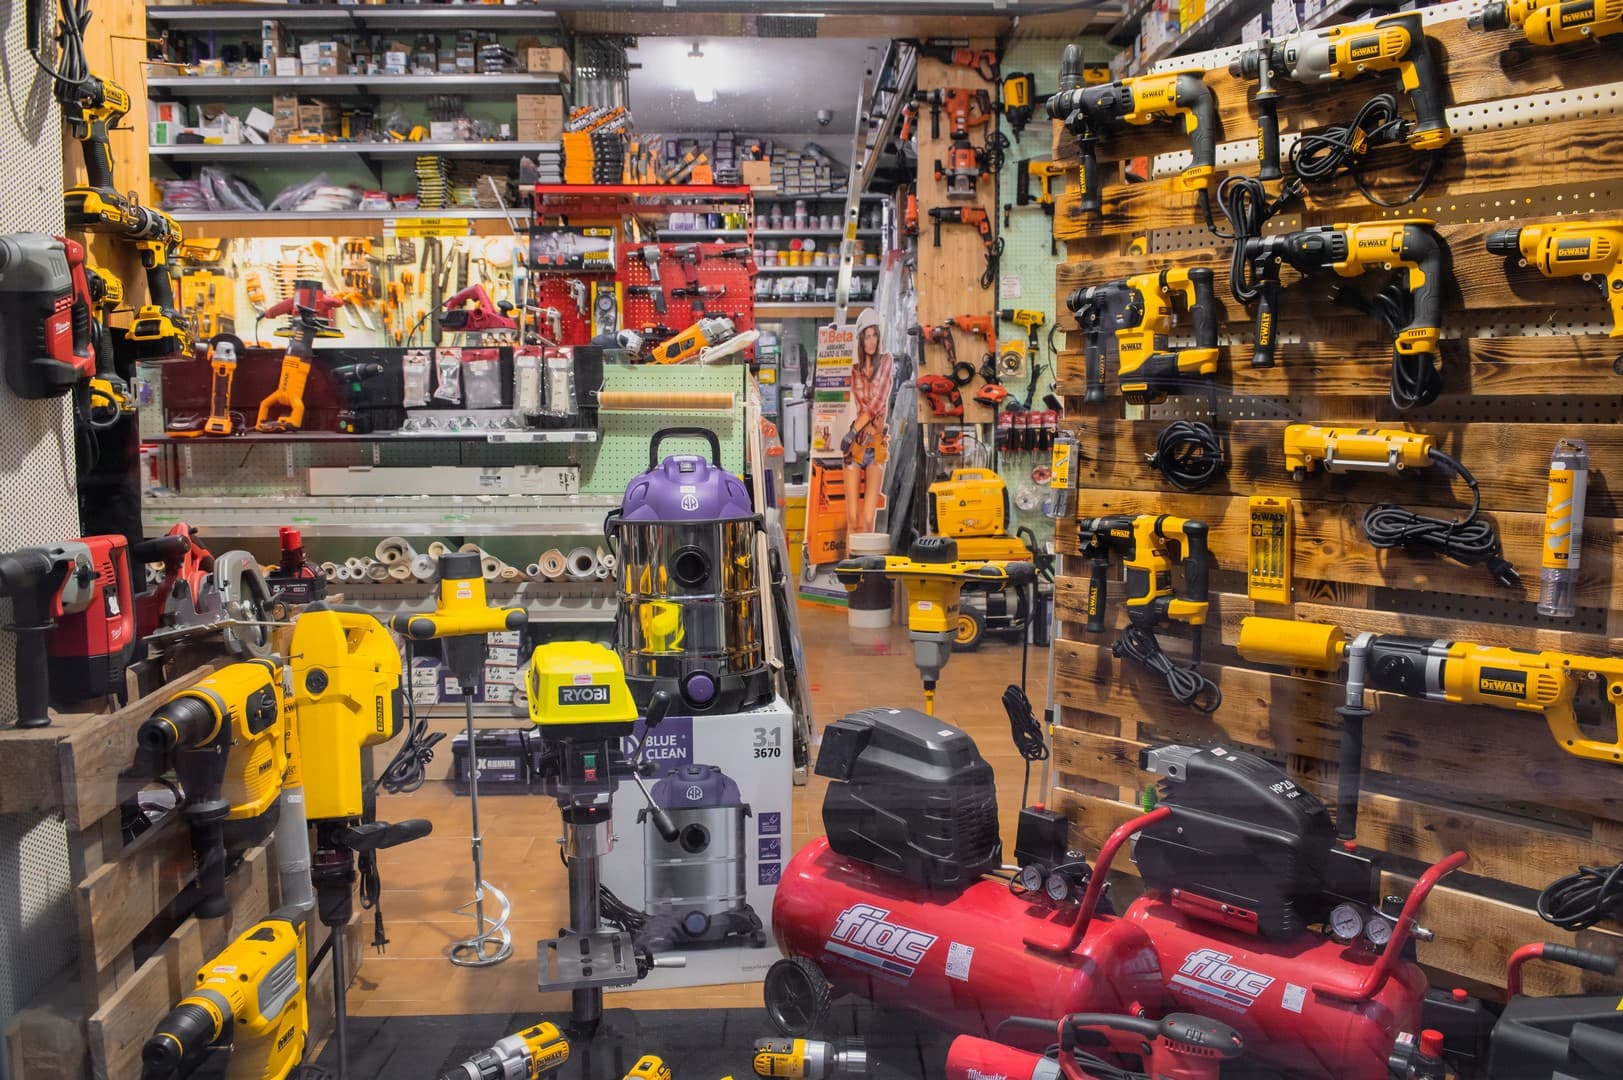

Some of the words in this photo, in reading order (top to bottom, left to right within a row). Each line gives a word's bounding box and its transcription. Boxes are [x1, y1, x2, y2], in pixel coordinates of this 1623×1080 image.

[1562, 10, 1594, 23] DeWALT
[1352, 45, 1378, 57] DeWALT
[1142, 90, 1164, 99] DeWALT
[1358, 239, 1387, 248] DeWALT
[1558, 247, 1588, 256] DeWALT
[1260, 312, 1271, 345] DeWALT
[828, 330, 853, 343] Beta
[1121, 343, 1142, 351] DeWALT
[1251, 512, 1286, 521] DeWALT
[1110, 529, 1130, 538] DeWALT
[1089, 586, 1098, 616] DeWALT
[1480, 678, 1525, 693] DeWALT
[562, 688, 607, 702] RYOBI
[646, 735, 677, 746] BLUE
[646, 748, 686, 759] CLEAN
[753, 748, 780, 758] 3670
[832, 904, 937, 963] fiac
[1180, 949, 1275, 997] fiac
[537, 1050, 562, 1065] DeWALT
